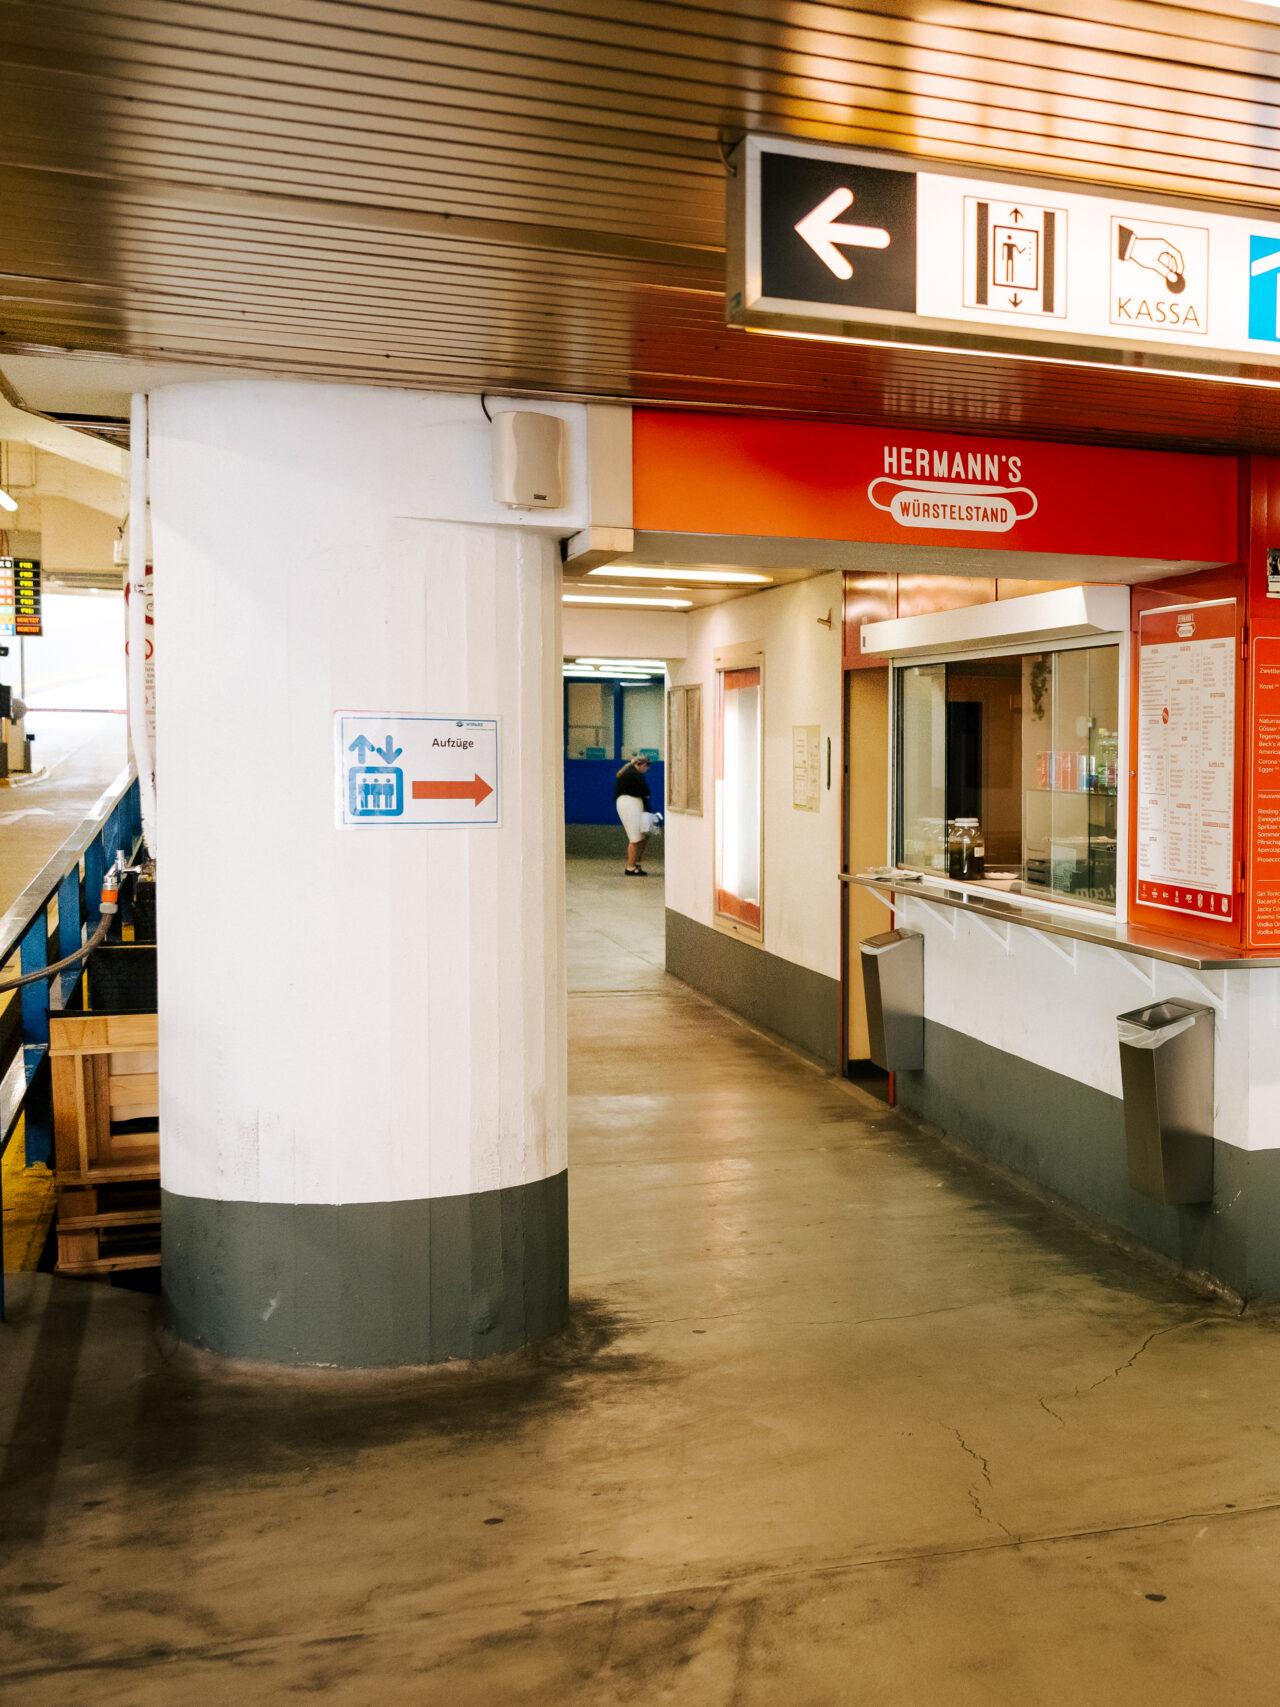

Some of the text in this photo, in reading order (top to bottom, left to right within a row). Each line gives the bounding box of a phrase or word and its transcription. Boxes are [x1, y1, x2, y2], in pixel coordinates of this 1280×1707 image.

[1119, 297, 1200, 327] KASSA
[884, 446, 1021, 483] HERMANN'S
[900, 499, 1007, 523] WÜRSTELSTAND
[432, 738, 474, 750] Aufzüge
